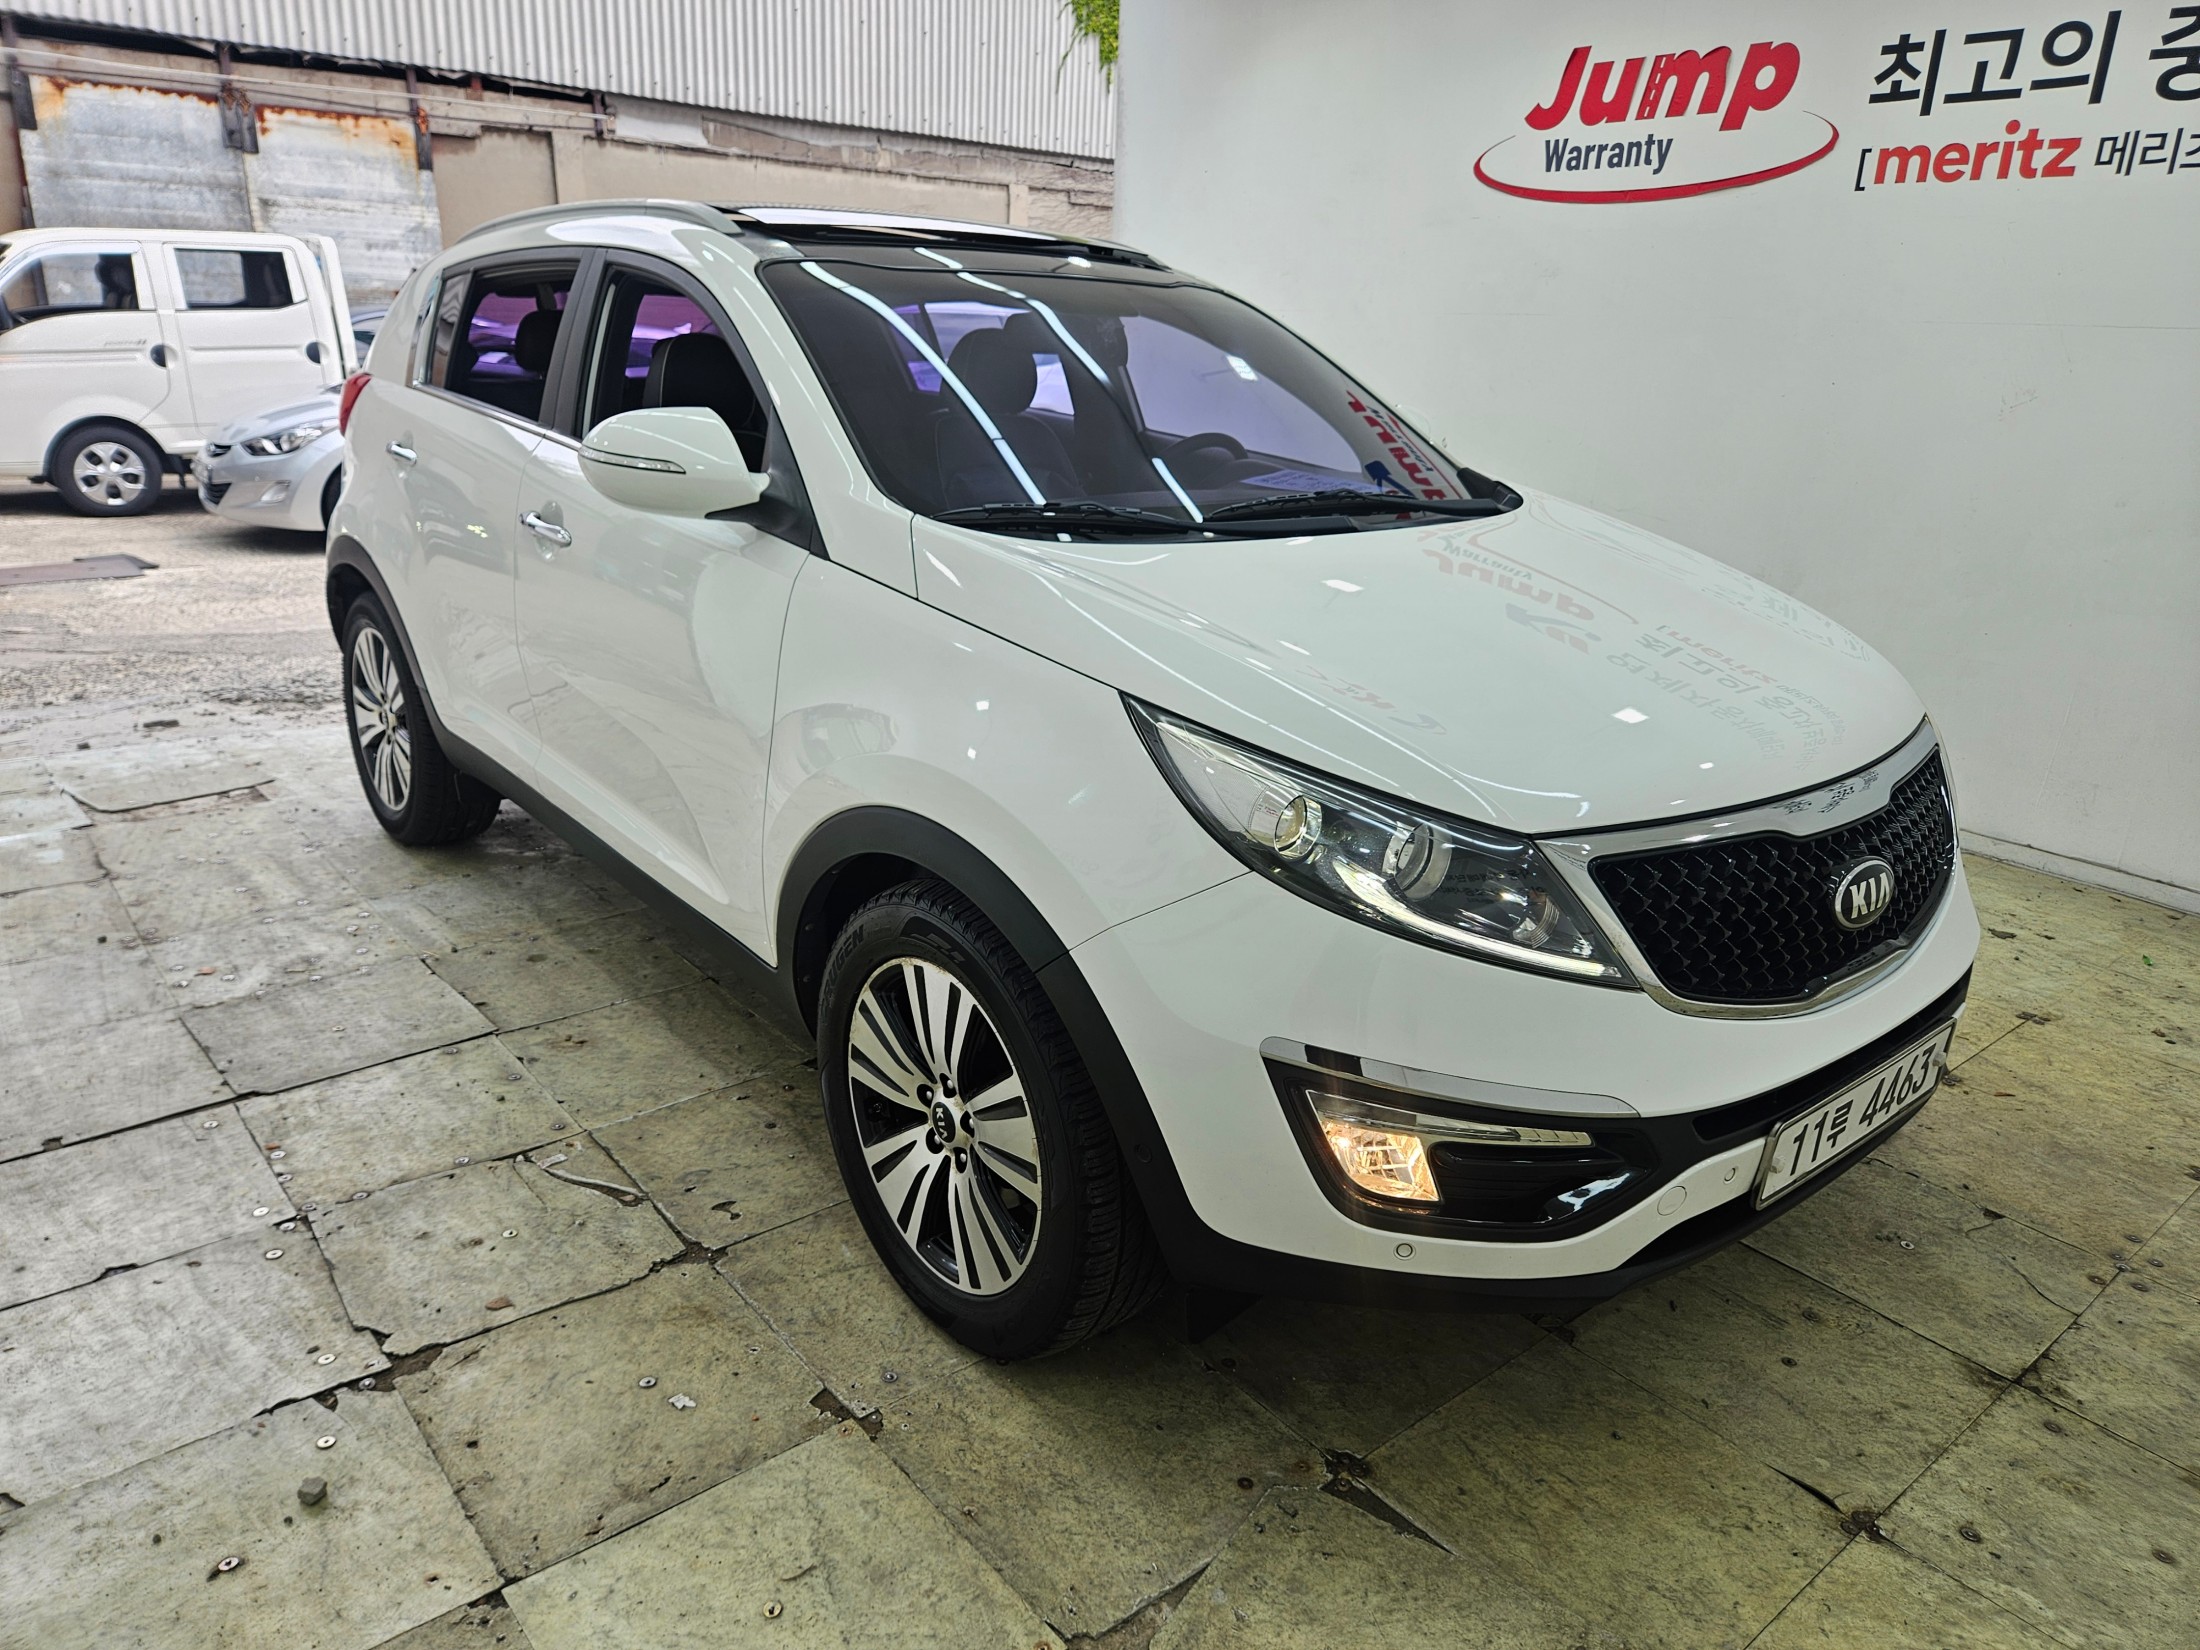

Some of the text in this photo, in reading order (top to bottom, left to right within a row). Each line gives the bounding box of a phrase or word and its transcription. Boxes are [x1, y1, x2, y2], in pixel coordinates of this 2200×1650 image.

[1524, 41, 1801, 132] Jump
[1868, 10, 2122, 116] 최고의
[1545, 133, 1674, 175] Warranty
[1849, 872, 1890, 919] KIA
[935, 1106, 949, 1140] KIA
[1790, 1043, 1937, 1176] 11루 4463
